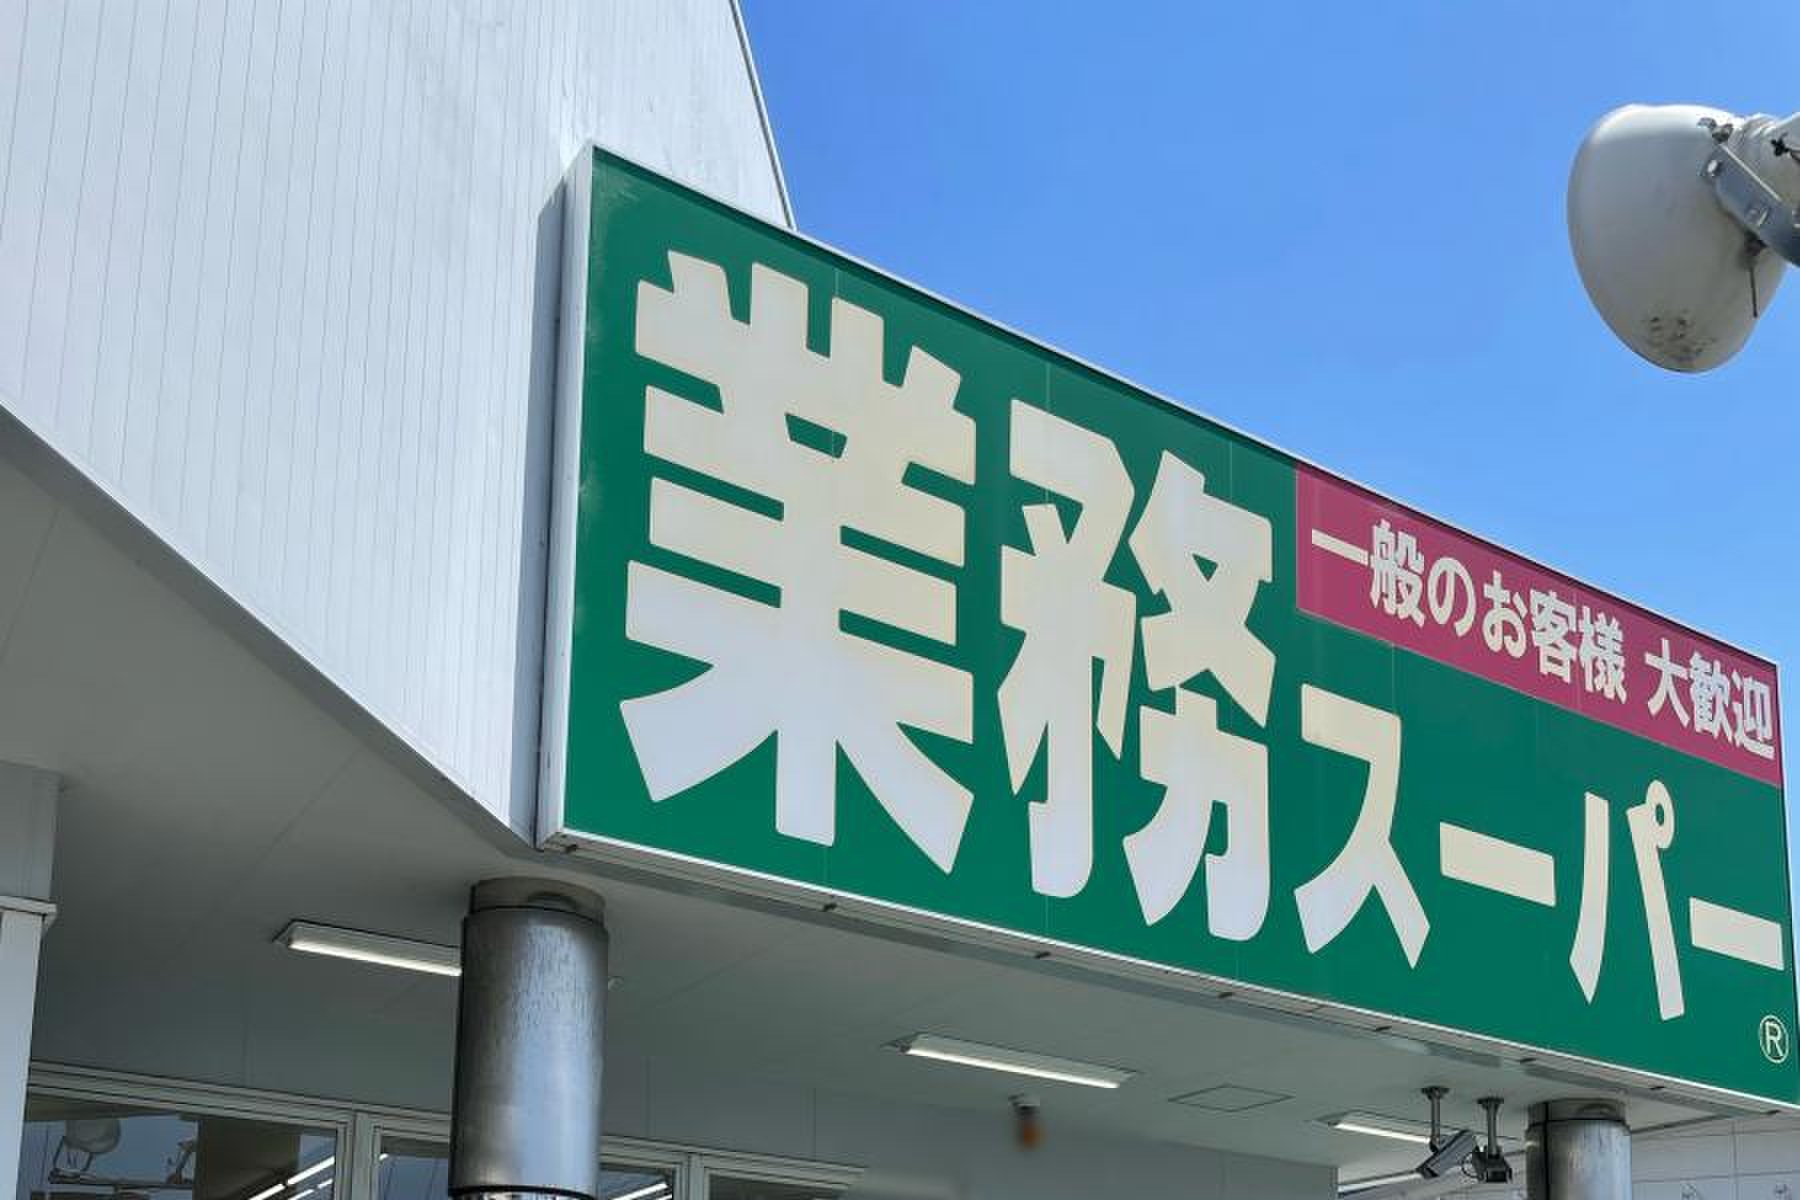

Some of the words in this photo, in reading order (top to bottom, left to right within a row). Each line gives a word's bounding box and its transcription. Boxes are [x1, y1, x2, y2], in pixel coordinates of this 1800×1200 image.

[620, 250, 1784, 1021] 業務スーパー
[1311, 519, 1627, 703] 一般のお客様
[1644, 638, 1775, 760] 大歓迎
